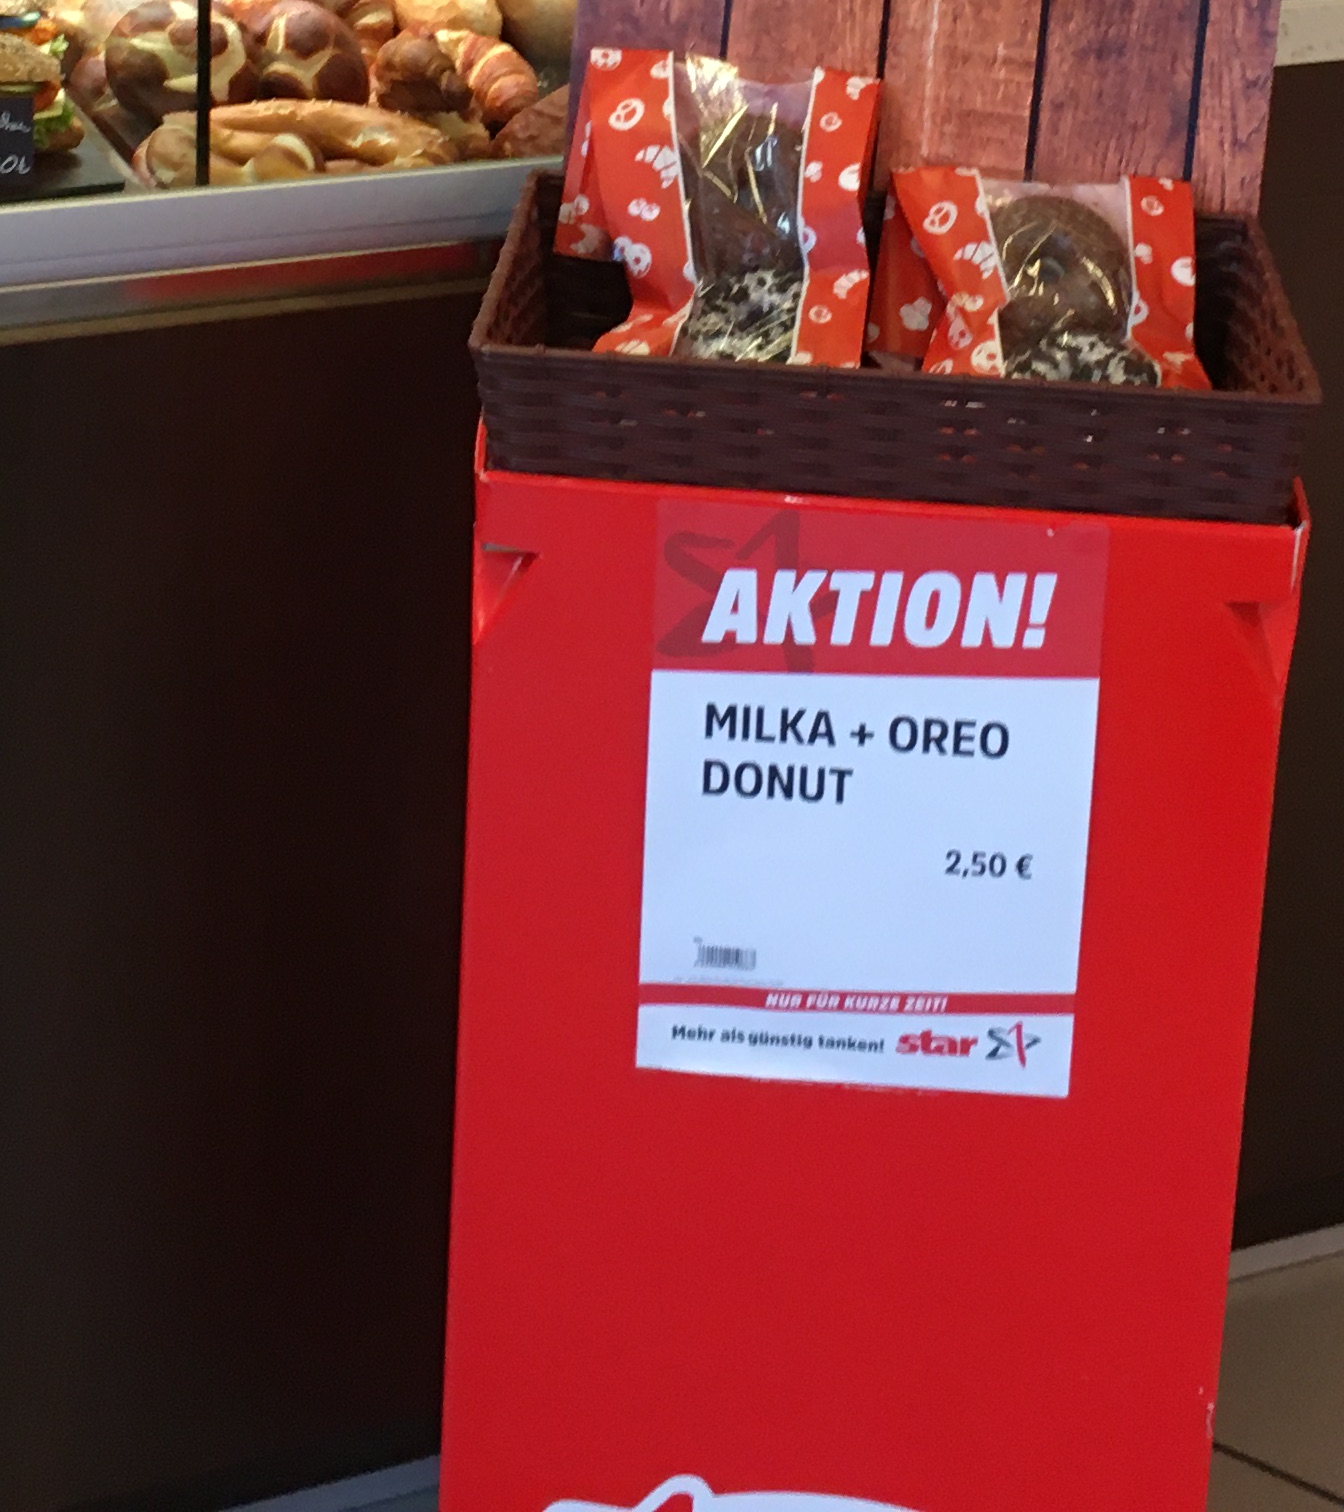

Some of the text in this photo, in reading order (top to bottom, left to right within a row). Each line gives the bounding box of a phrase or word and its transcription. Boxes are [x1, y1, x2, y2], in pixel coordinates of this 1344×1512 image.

[702, 567, 1058, 650] AKTION!
[704, 702, 1011, 759] MILKA + OREO
[701, 759, 855, 805] DONUT
[944, 850, 1034, 880] 2,50 €
[765, 989, 949, 1013] NUR FÜR KURZE ZEIT!
[671, 1024, 885, 1054] Mehr als günstig tanken!
[895, 1028, 979, 1057] star
